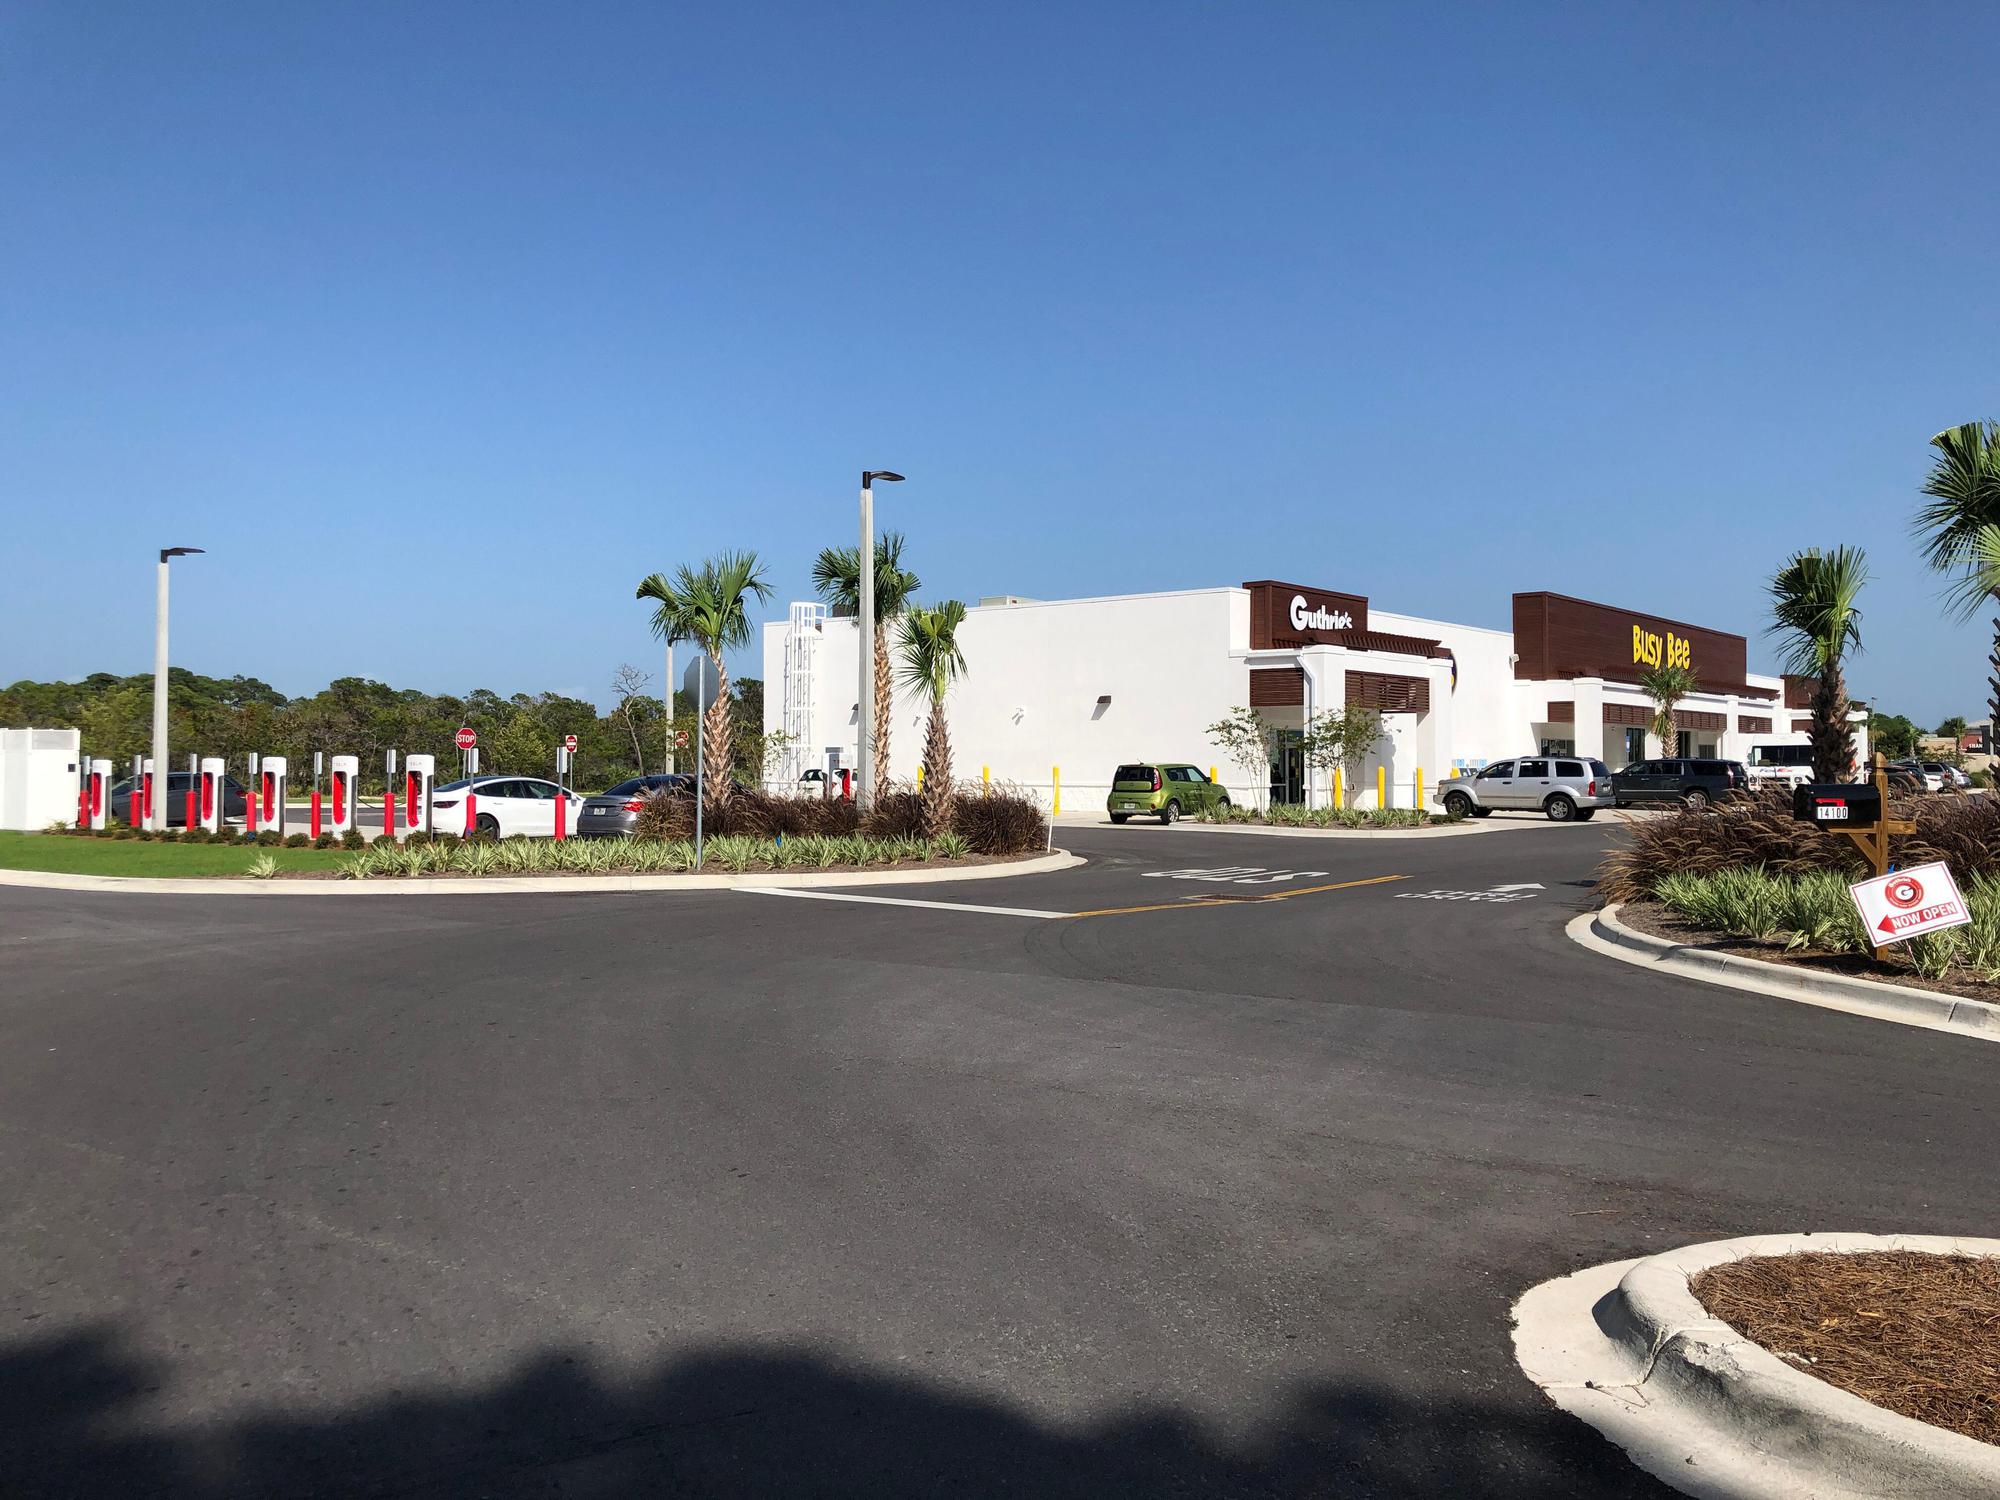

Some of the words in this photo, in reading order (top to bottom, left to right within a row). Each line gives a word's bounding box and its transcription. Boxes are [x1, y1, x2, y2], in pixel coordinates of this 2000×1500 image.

[1290, 595, 1353, 631] Guthrie's
[1633, 625, 1663, 670] Busy
[1667, 632, 1690, 670] Bee
[457, 734, 475, 743] STOP
[1820, 807, 1847, 818] 14100
[1892, 911, 1921, 929] NOW
[1922, 902, 1957, 920] OPEN
